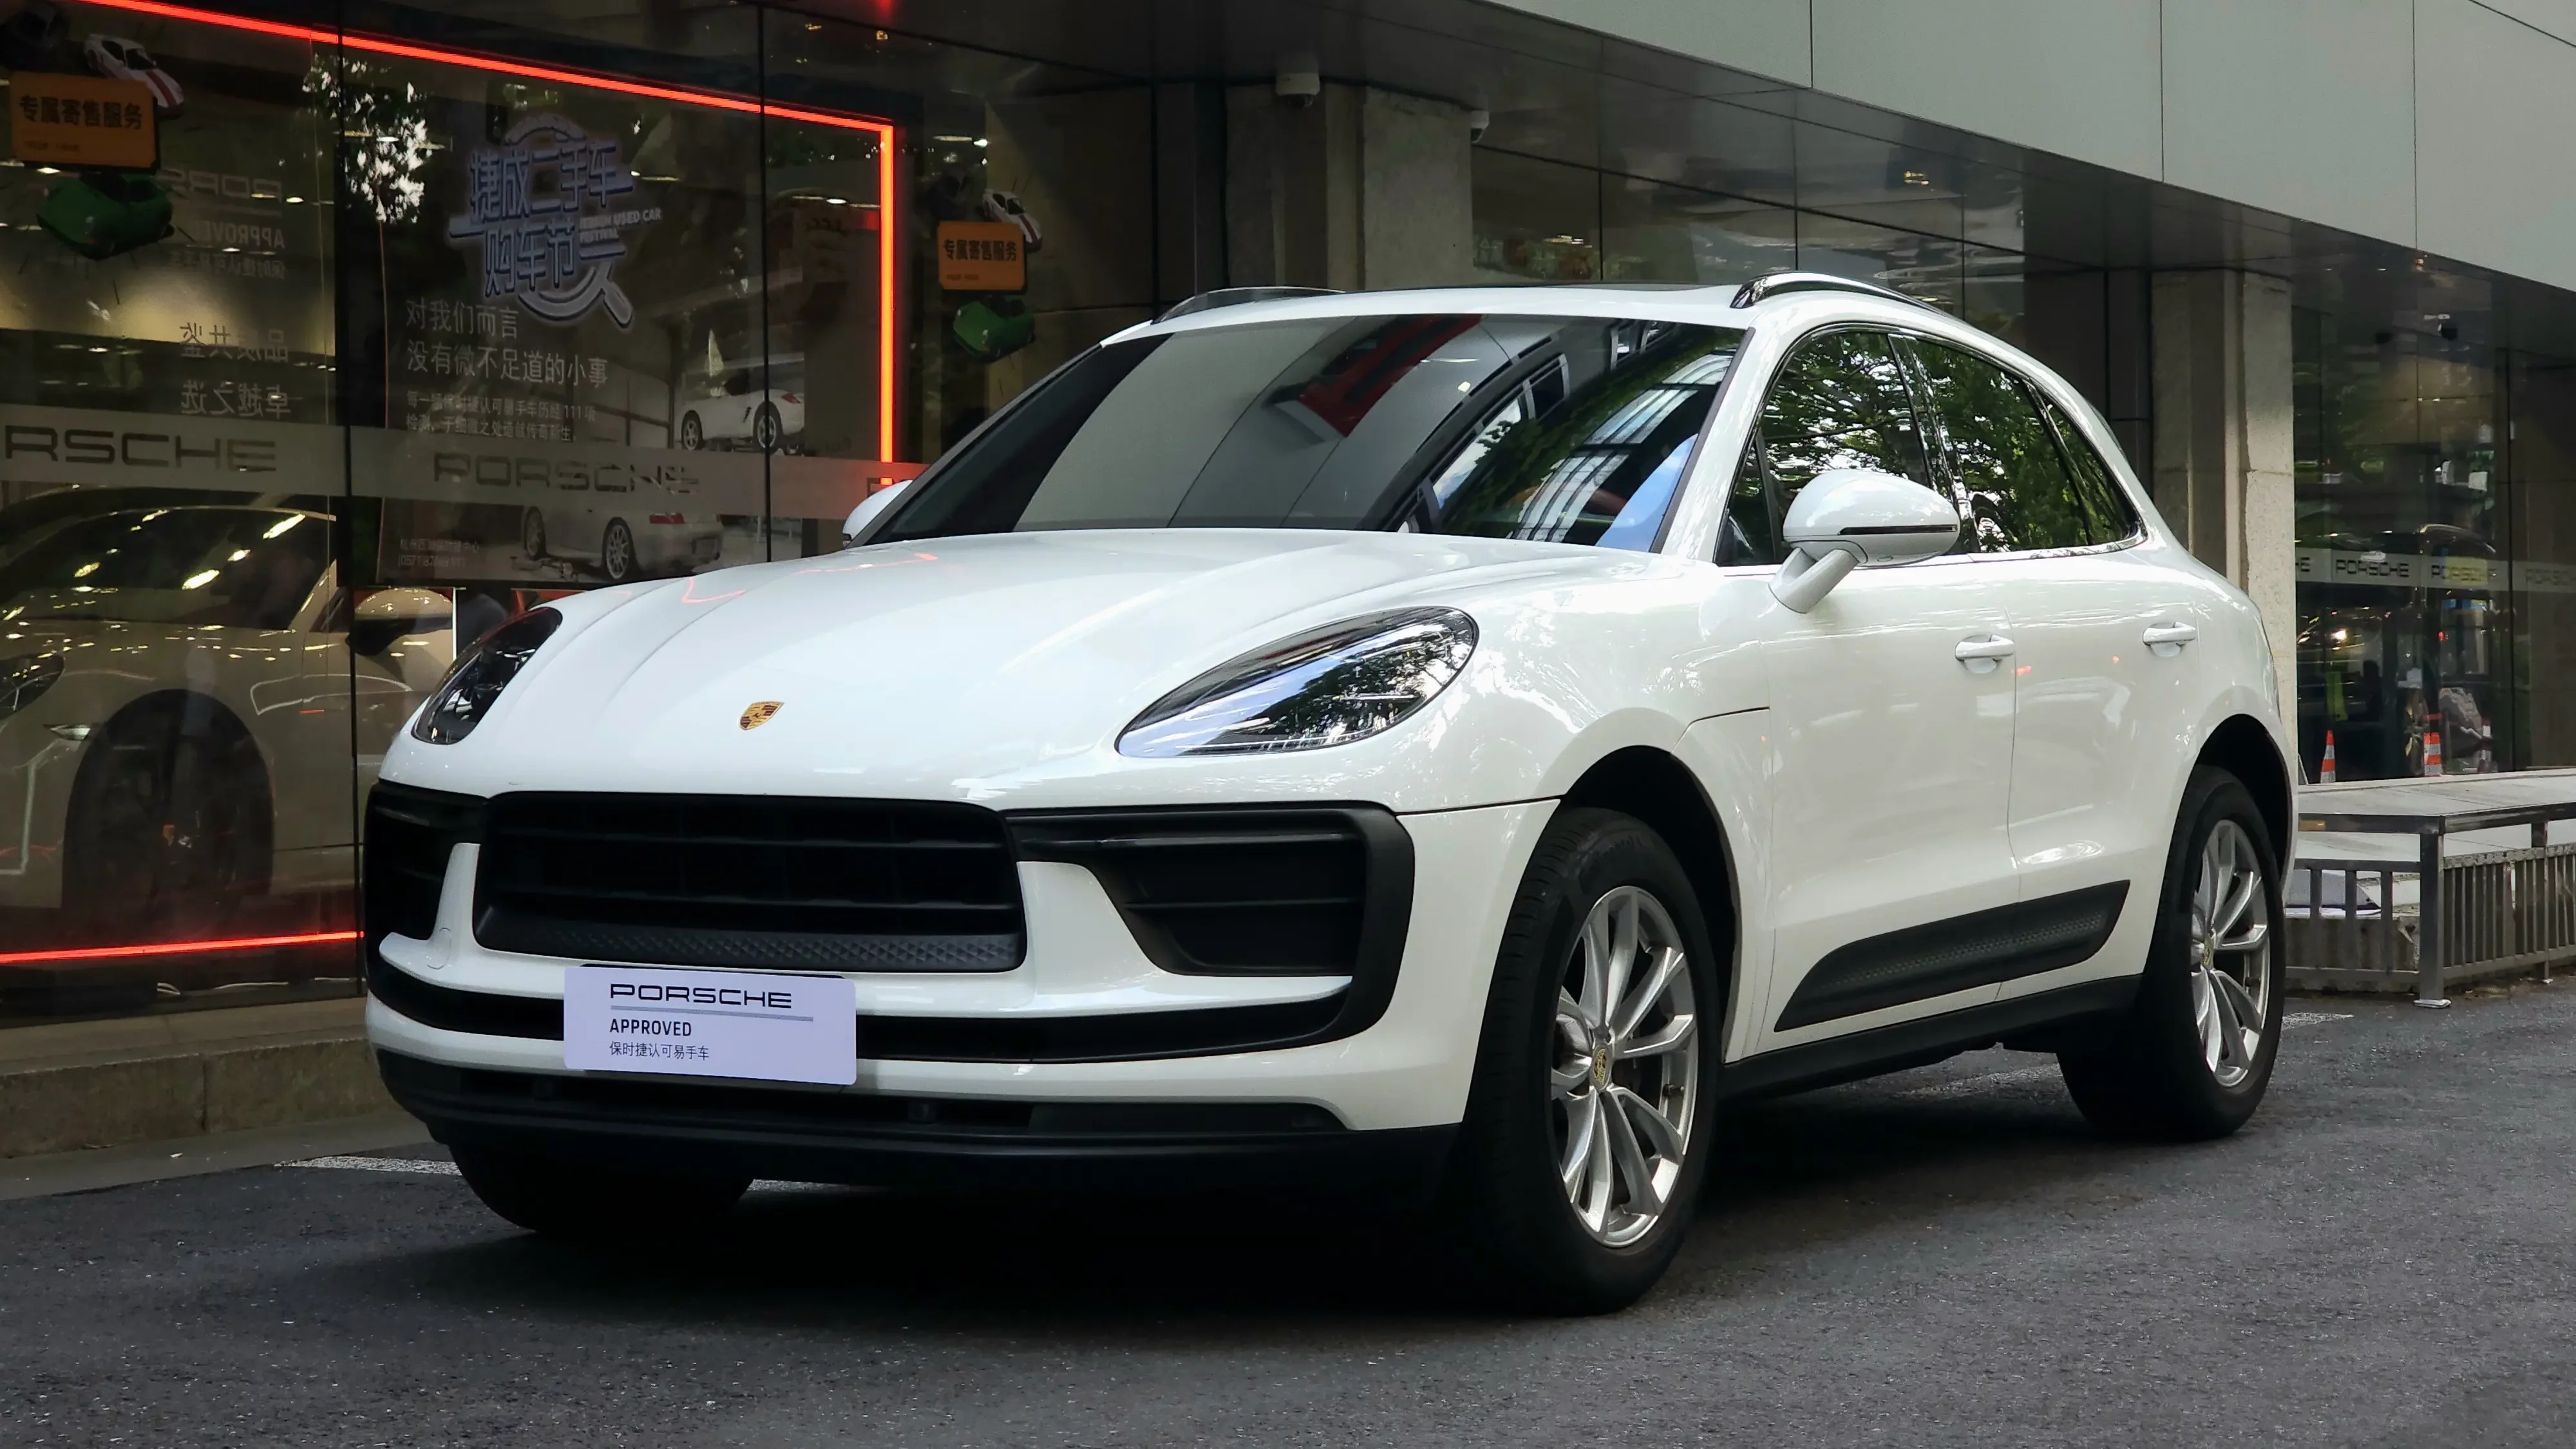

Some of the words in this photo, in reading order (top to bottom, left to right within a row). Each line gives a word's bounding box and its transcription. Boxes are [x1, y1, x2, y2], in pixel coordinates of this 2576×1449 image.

[19, 94, 142, 130] 专属寄售服务
[470, 142, 634, 224] 捷成二手车
[643, 207, 663, 223] CAR
[485, 217, 575, 298] 购车节
[406, 297, 518, 340] 对我们而言
[407, 339, 609, 388] 没有微不足道的小事
[433, 452, 700, 495] PORSCHE
[2336, 559, 2410, 578] PORSCHE
[609, 983, 792, 1010] PORSCHE
[609, 1018, 692, 1037] APPROVED
[609, 1041, 710, 1061] 保时捷认可易手车
